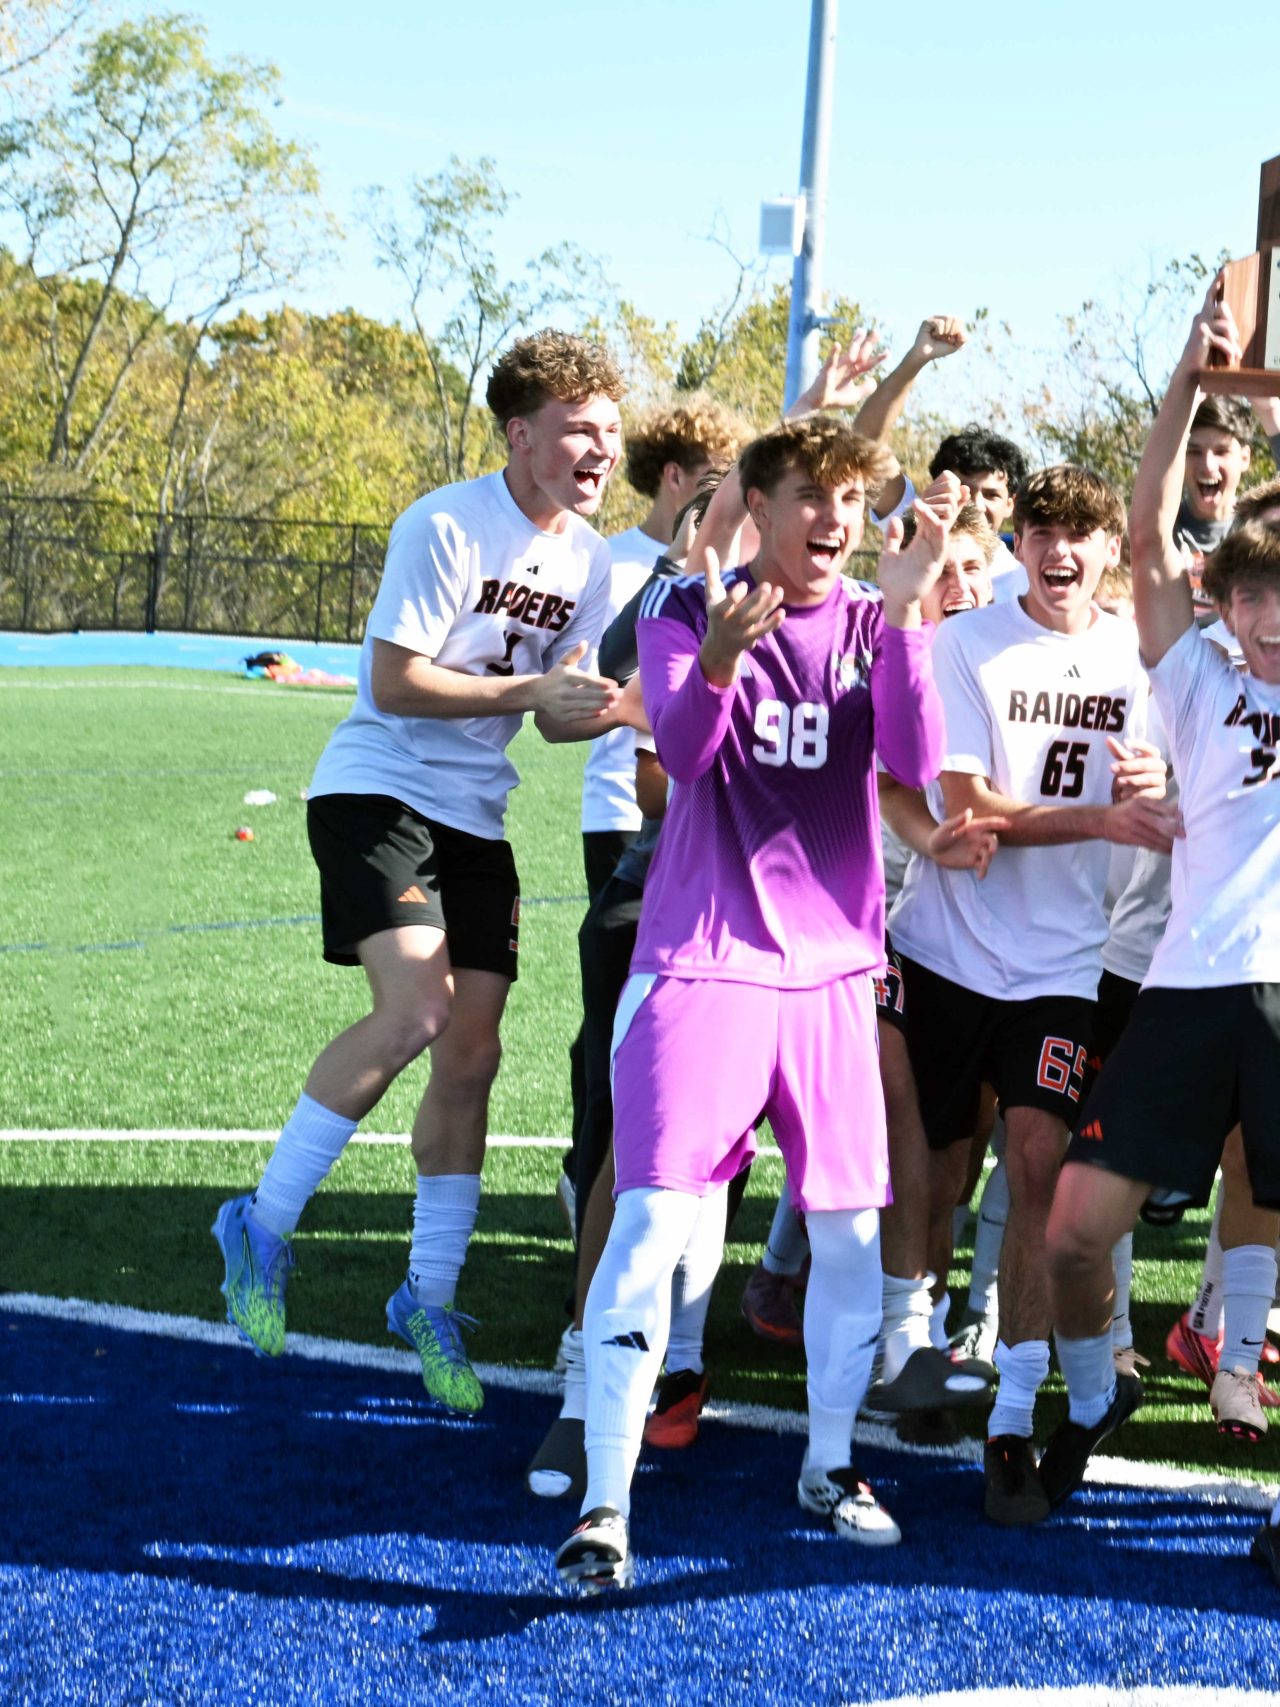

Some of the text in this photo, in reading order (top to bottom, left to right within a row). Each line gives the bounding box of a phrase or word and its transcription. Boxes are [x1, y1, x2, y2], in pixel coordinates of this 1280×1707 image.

[473, 579, 576, 632] RADERS
[753, 698, 830, 769] 98
[1008, 689, 1126, 733] RAIDERS
[1040, 740, 1090, 798] 65
